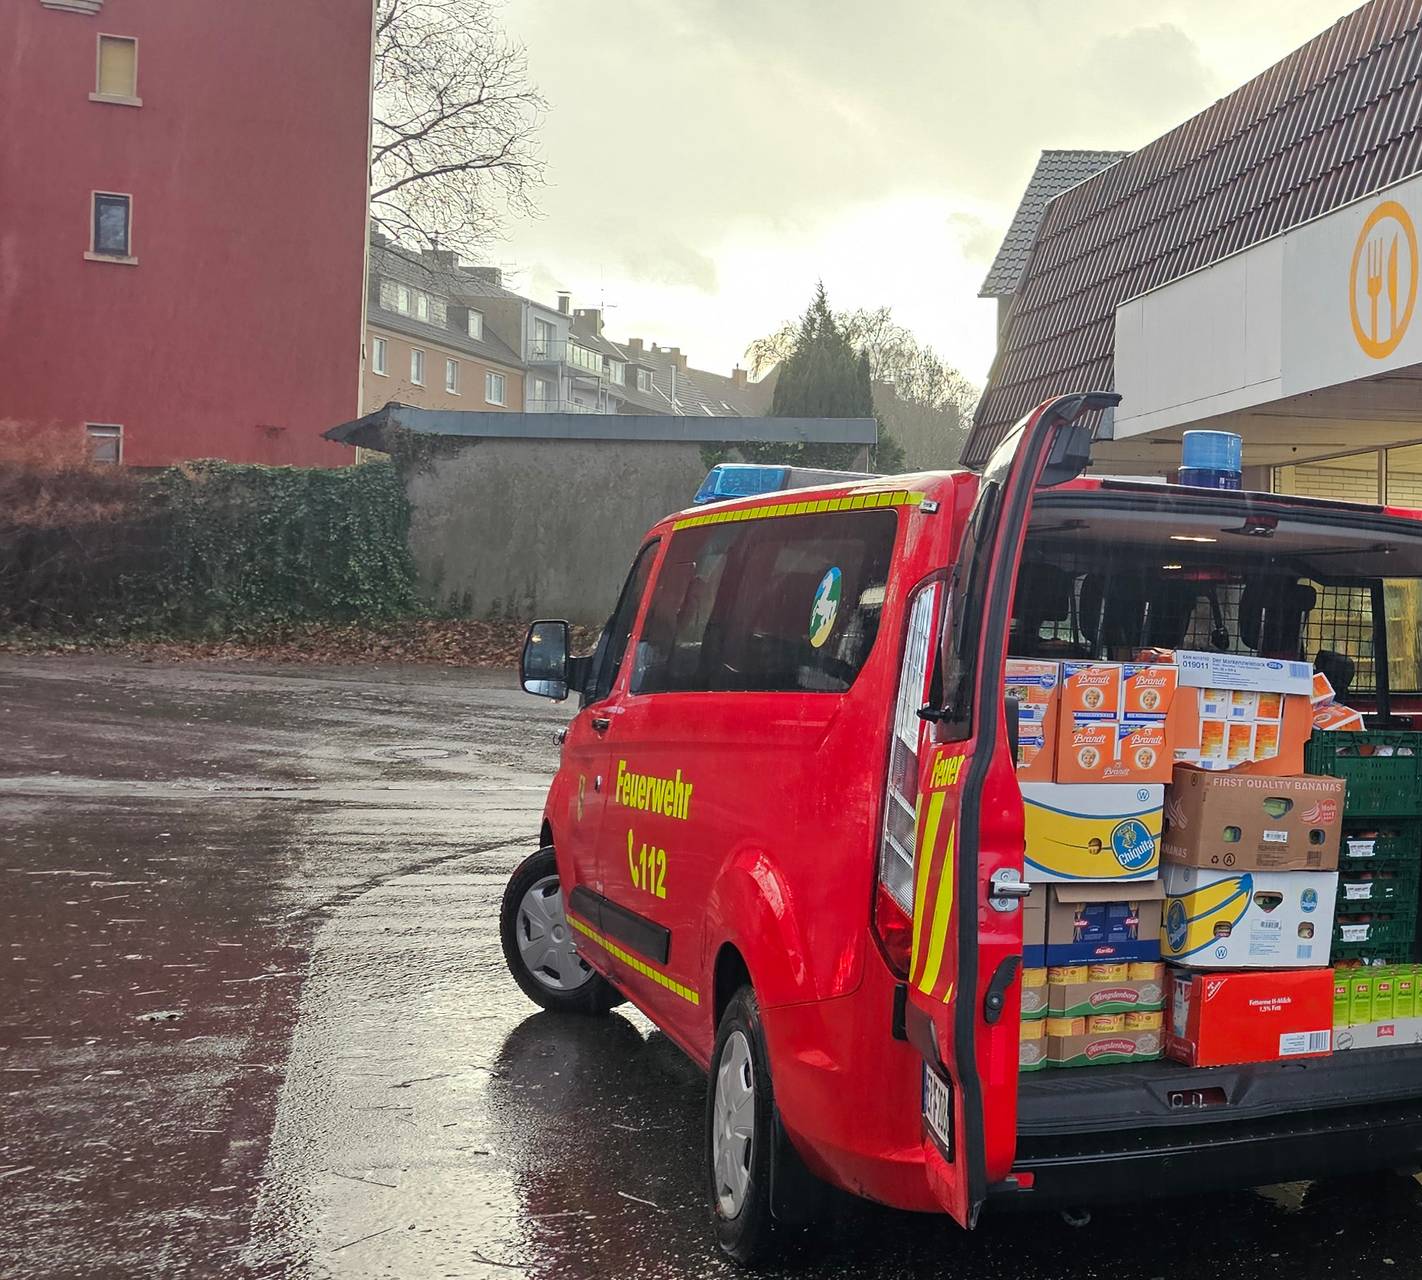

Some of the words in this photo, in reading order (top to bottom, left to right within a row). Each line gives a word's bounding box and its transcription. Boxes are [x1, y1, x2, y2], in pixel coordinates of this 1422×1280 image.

[1078, 672, 1110, 687] Brandt
[1135, 674, 1167, 688] Brandt
[1072, 732, 1106, 747] Brandt
[1129, 733, 1163, 748] Brandt
[929, 750, 965, 789] Feuer
[1102, 767, 1130, 779] Brandt
[616, 759, 693, 820] Feuerwehr
[1213, 777, 1244, 788] FIRST
[1247, 778, 1292, 791] QUALITY
[1294, 779, 1342, 792] BANANAS
[1118, 839, 1155, 866] Chiquita
[639, 843, 667, 900] 112
